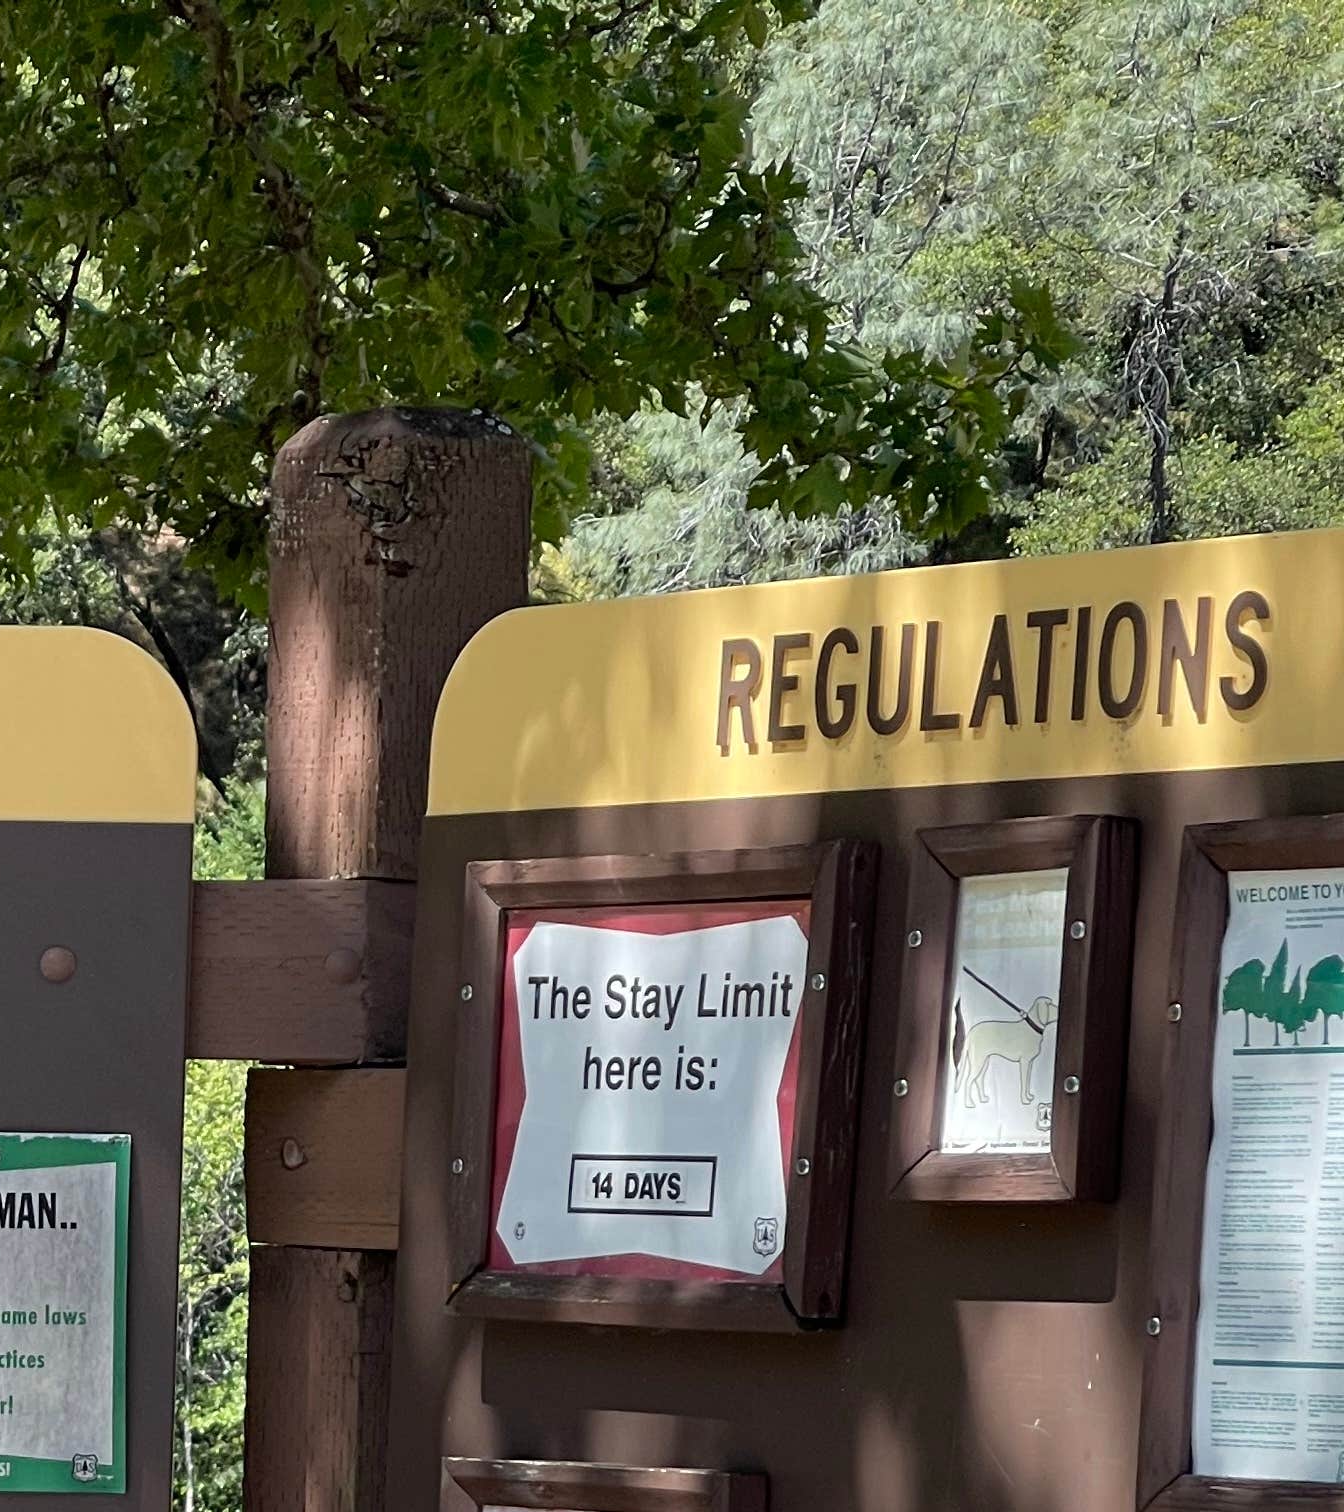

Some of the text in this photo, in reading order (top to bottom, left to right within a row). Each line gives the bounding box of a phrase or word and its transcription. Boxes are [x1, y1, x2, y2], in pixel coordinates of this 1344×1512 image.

[716, 590, 1272, 747] REGULATIONS
[1236, 884, 1309, 904] WELCOME
[1313, 883, 1332, 899] TO
[528, 971, 793, 1031] The Stay Limit
[582, 1045, 718, 1090] here is:
[591, 1172, 682, 1200] 14 DAYS
[45, 1304, 87, 1326] laws
